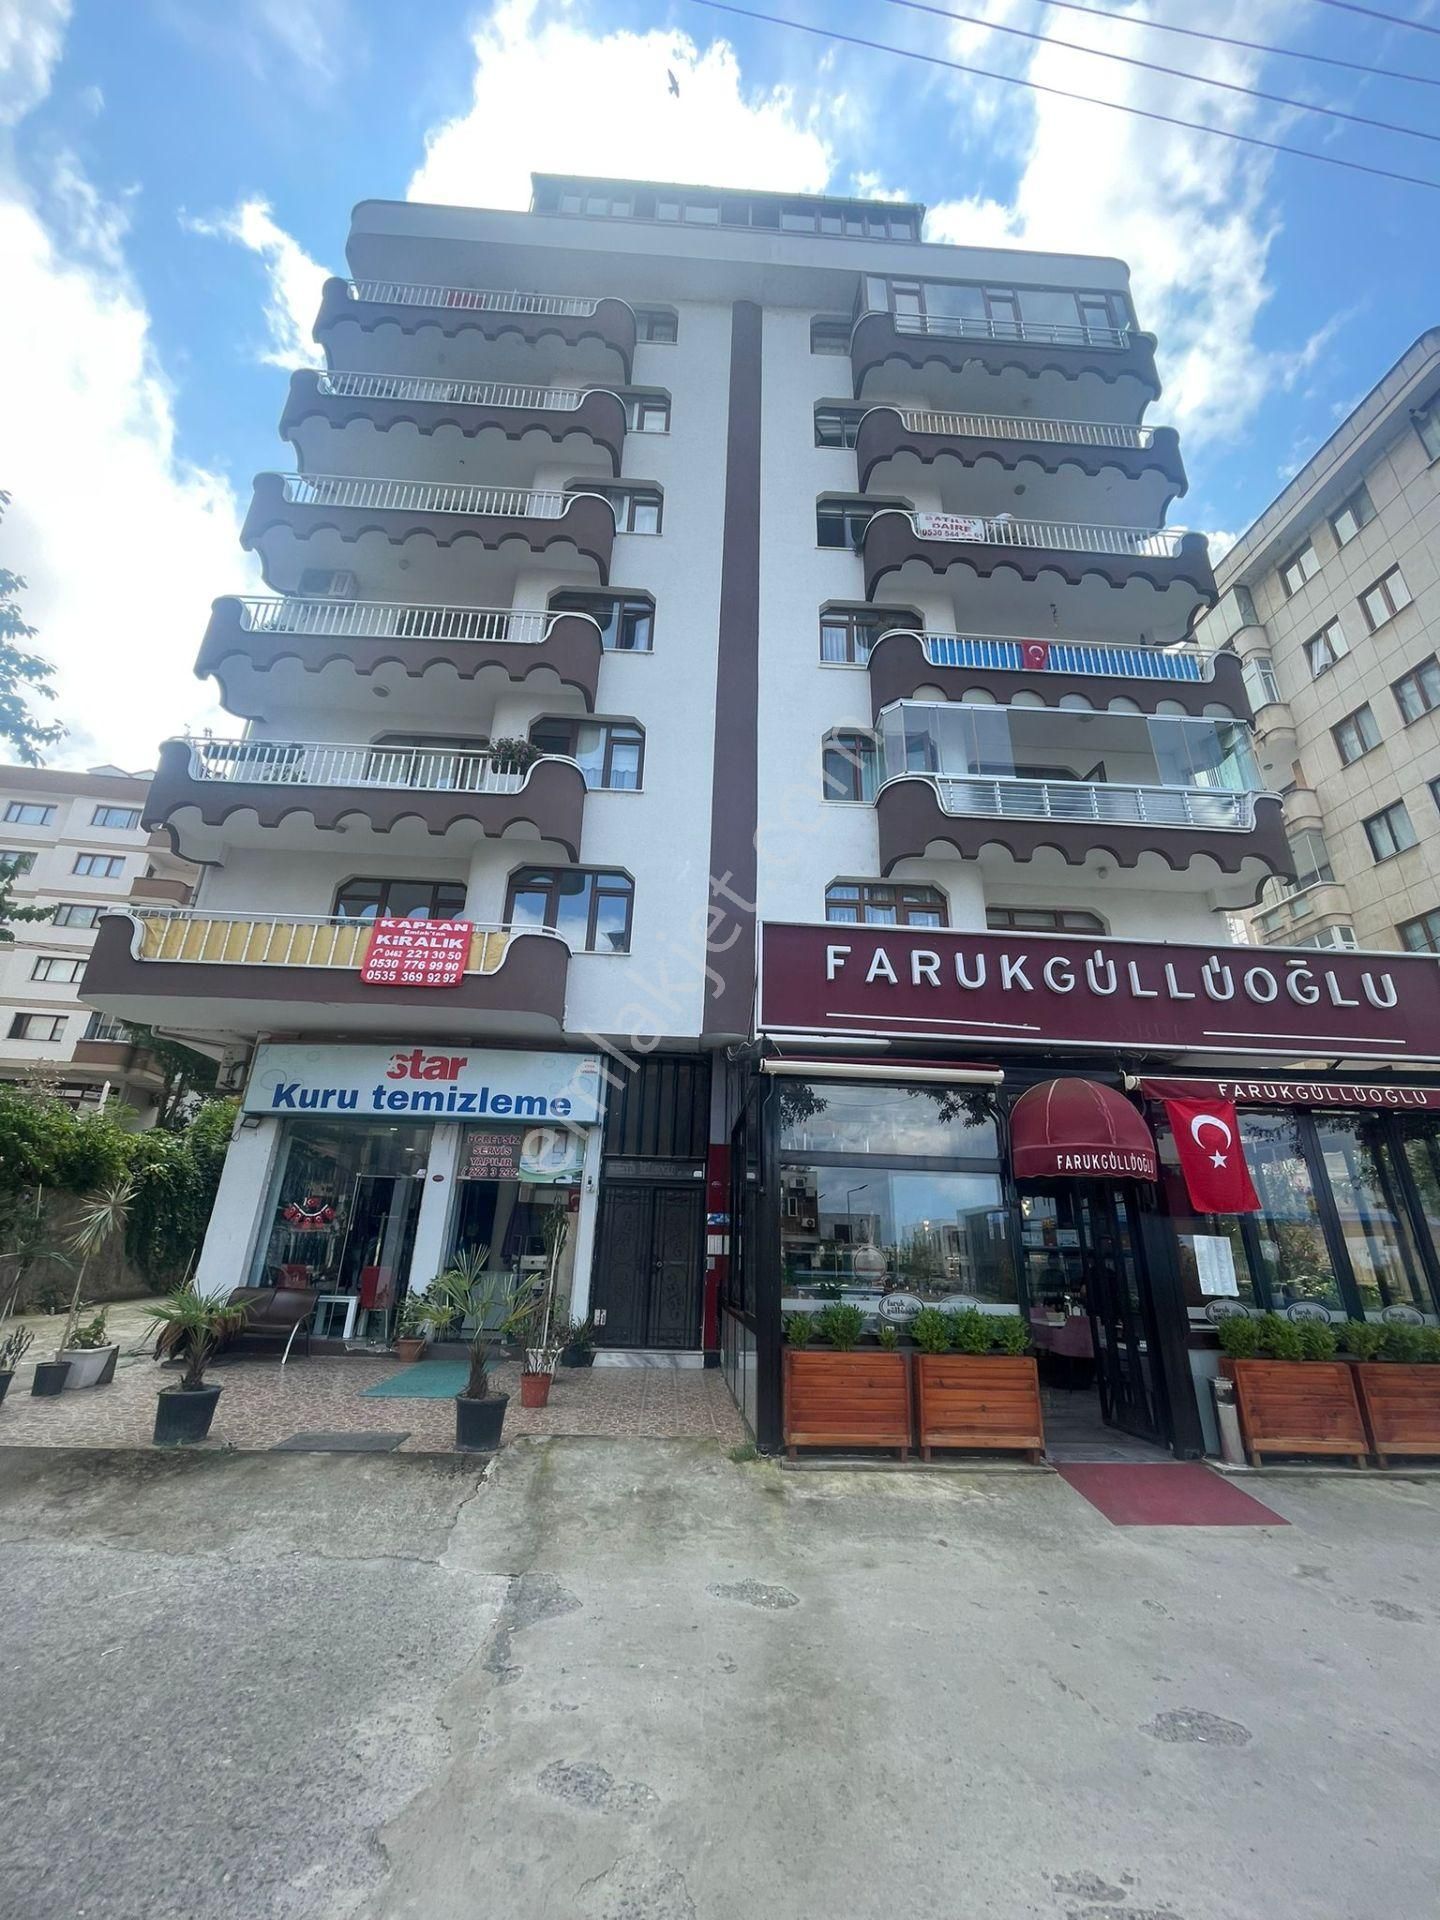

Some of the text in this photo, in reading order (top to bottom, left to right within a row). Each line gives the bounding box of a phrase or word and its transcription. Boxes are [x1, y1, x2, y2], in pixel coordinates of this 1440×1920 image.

[380, 920, 469, 932] KAPLAN
[406, 949, 429, 959] 221
[432, 951, 446, 959] 30
[447, 951, 462, 961] 50
[369, 958, 459, 972] 0530 776 99 90
[366, 970, 457, 984] 0535 369 92 92
[826, 945, 1399, 1009] FARUKGÜLLÜOĞLU
[386, 1049, 468, 1081] star
[271, 1083, 572, 1118] Kuru temizleme
